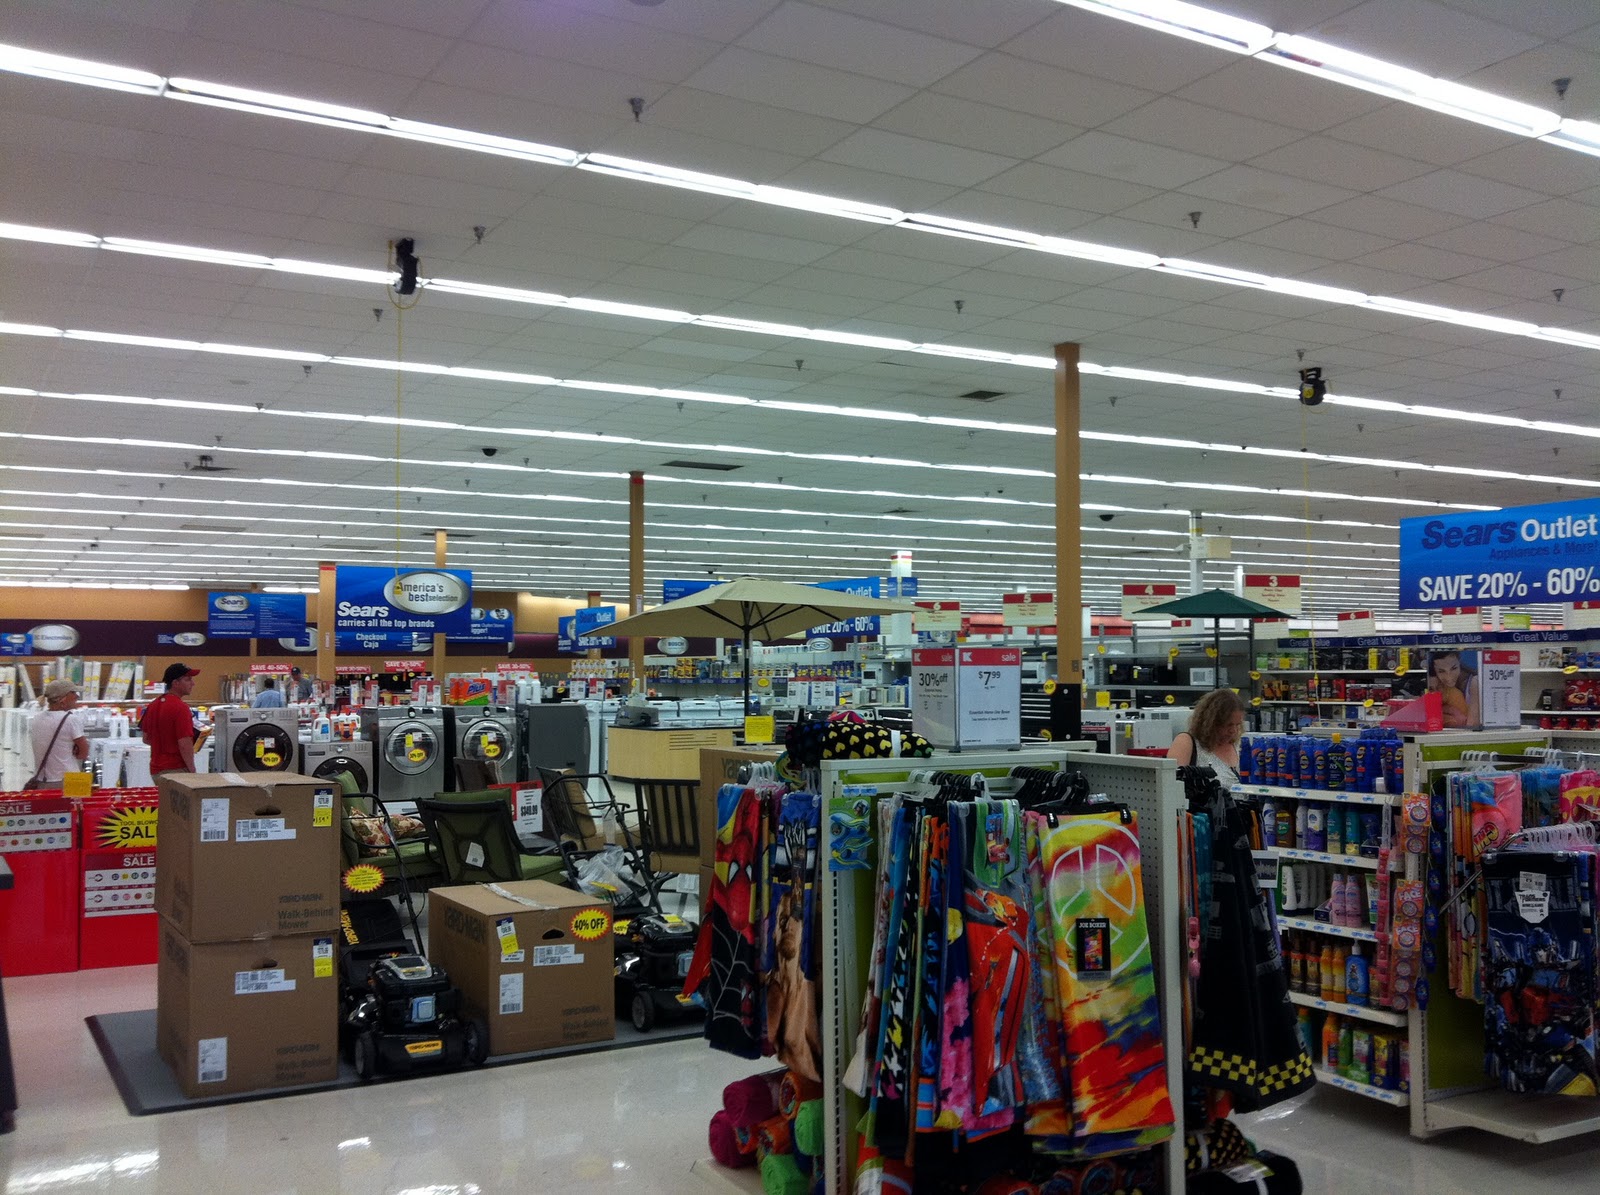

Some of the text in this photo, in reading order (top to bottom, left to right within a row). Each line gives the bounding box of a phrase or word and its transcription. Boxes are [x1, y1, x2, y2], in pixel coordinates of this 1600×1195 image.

[1421, 513, 1598, 550] Sears Outlet
[1489, 546, 1550, 561] Appliances
[1268, 575, 1279, 587] 3
[1418, 573, 1473, 602] SAVE
[1477, 571, 1528, 599] 20%
[1547, 565, 1600, 595] 60%
[1144, 585, 1154, 596] 4
[222, 598, 244, 606] Sears
[408, 592, 429, 602] best
[1023, 593, 1032, 603] 5
[337, 601, 389, 617] Sears
[933, 602, 941, 610] 6
[1581, 601, 1589, 609] 4
[597, 611, 612, 623] Outlet
[338, 618, 435, 629] carries all the top brands
[855, 615, 874, 632] 60%
[356, 633, 387, 641] Checkout
[1357, 636, 1402, 646] Great Value
[1432, 633, 1482, 644] Great Value
[1512, 631, 1569, 642] Great Value
[363, 641, 379, 649] Caja
[1289, 638, 1311, 647] Great
[941, 652, 953, 662] sale
[1001, 652, 1017, 662] sale
[918, 672, 949, 688] 30% off
[1489, 669, 1507, 681] 30%
[0, 804, 32, 815] SALE
[120, 826, 159, 840] SAL
[123, 856, 155, 867] SALE
[1399, 889, 1422, 901] FACE
[278, 907, 333, 919] Walk-Behind
[279, 920, 308, 930] Mower
[573, 920, 590, 931] 40%
[590, 918, 605, 929] OFF
